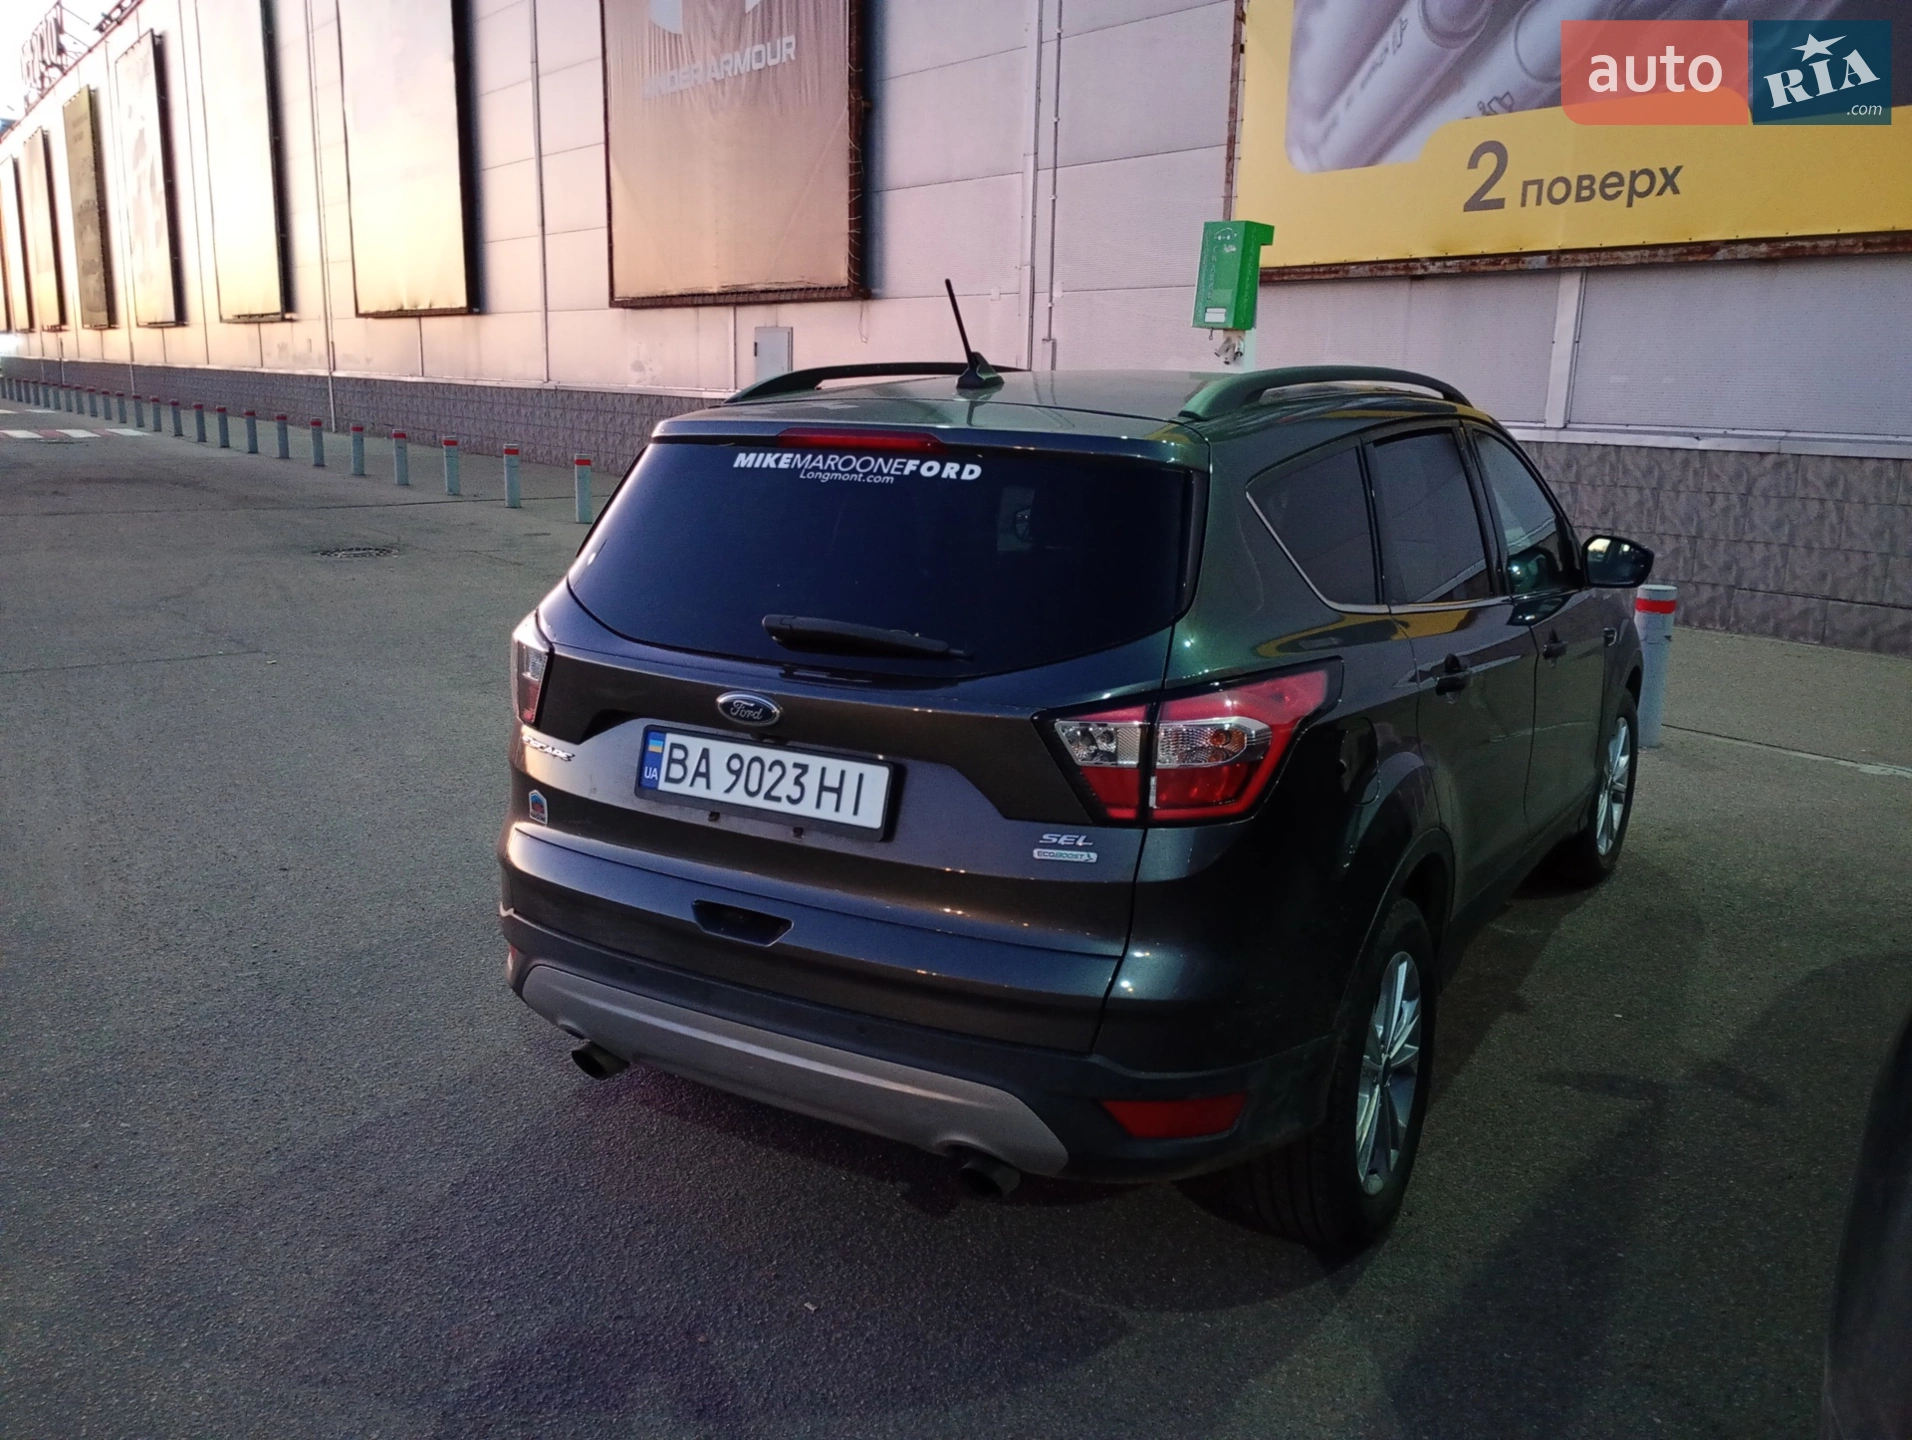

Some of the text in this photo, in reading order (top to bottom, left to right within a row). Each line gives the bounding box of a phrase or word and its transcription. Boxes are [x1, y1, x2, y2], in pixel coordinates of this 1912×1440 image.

[705, 34, 796, 82] ARMOUR
[1463, 140, 1684, 212] 2 поверх
[799, 469, 895, 484] Longmont.com
[729, 699, 764, 721] Ford
[644, 766, 659, 780] UA
[663, 742, 865, 817] BA 9023 HI
[1039, 833, 1094, 846] SEL
